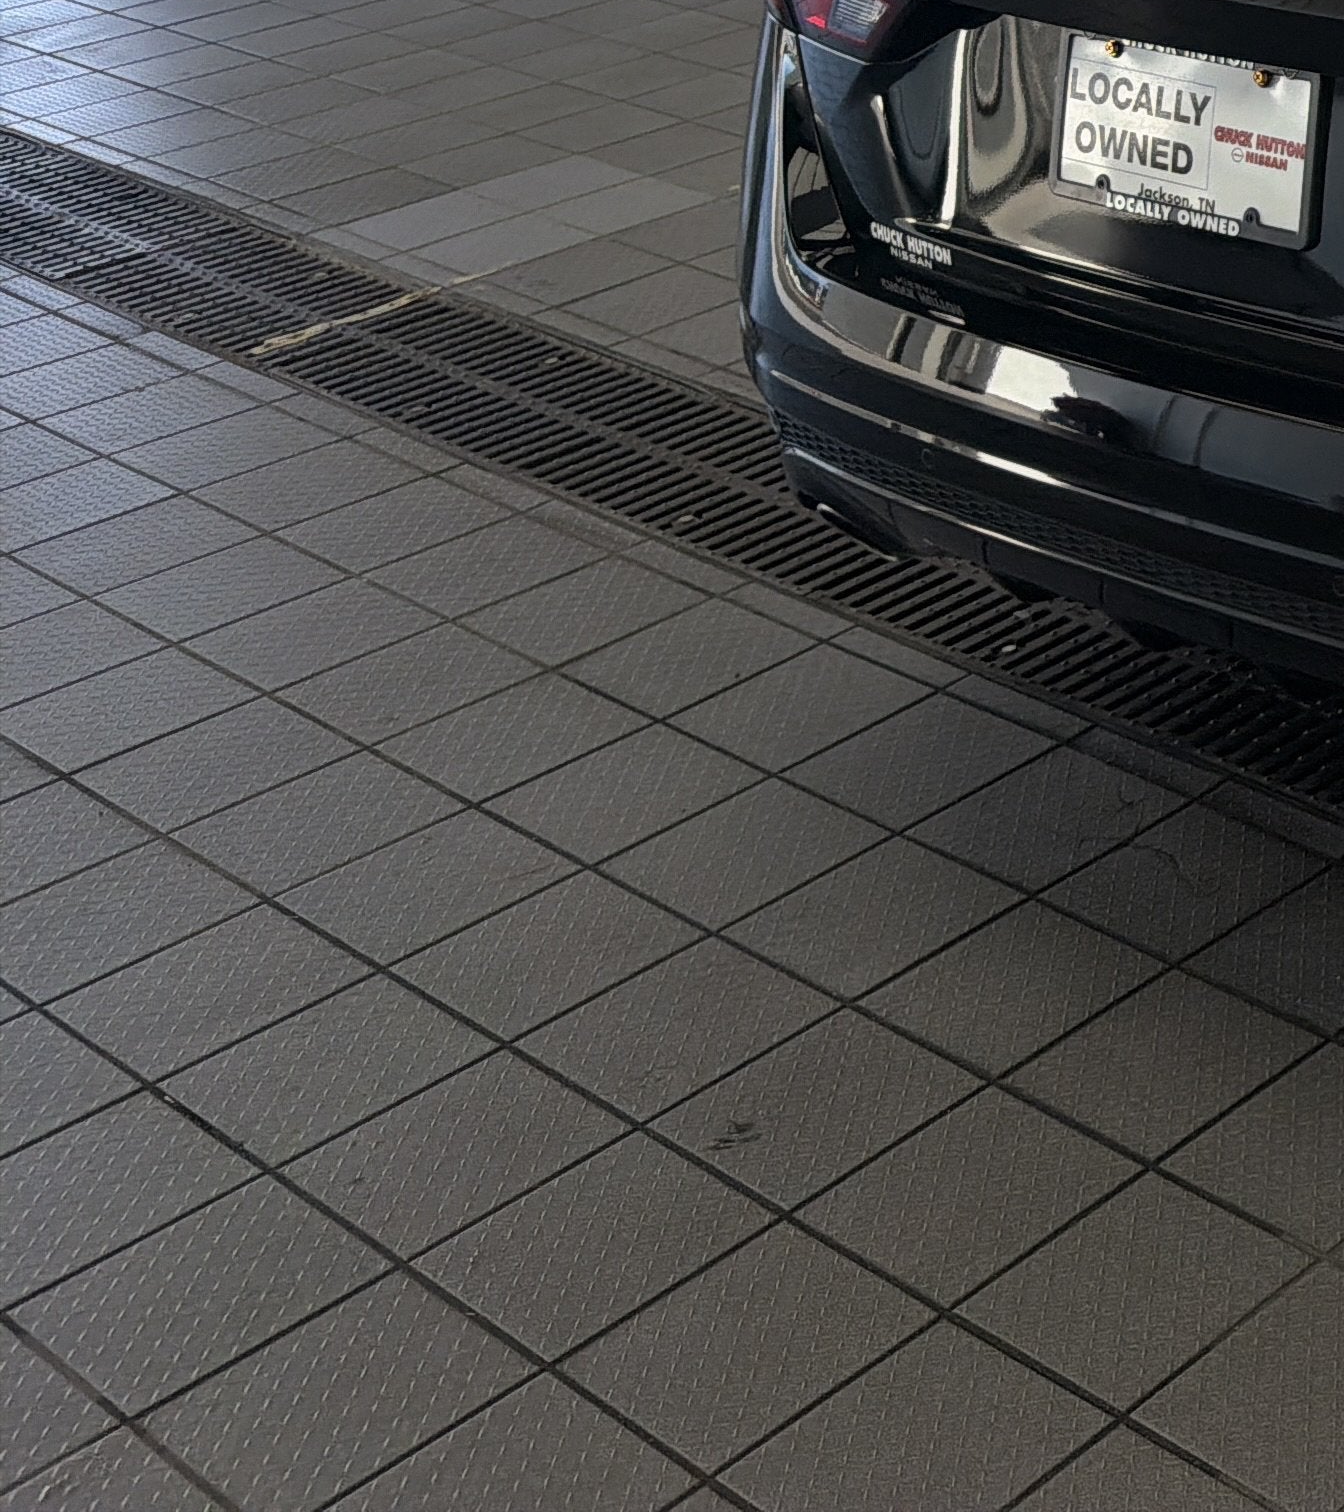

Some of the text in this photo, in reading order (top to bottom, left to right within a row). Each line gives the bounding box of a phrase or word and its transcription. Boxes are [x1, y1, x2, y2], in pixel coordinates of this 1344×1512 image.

[1070, 67, 1211, 126] LOCALLY
[1075, 120, 1193, 175] OWNED
[1214, 125, 1307, 160] CHUCK HUTTON
[1245, 150, 1288, 171] NISSAN
[1105, 191, 1241, 237] LOCALLY OWNED
[1137, 182, 1216, 214] Jackson, TN
[870, 221, 952, 266] CHUCK HUTTON
[890, 246, 933, 270] NISSAN
